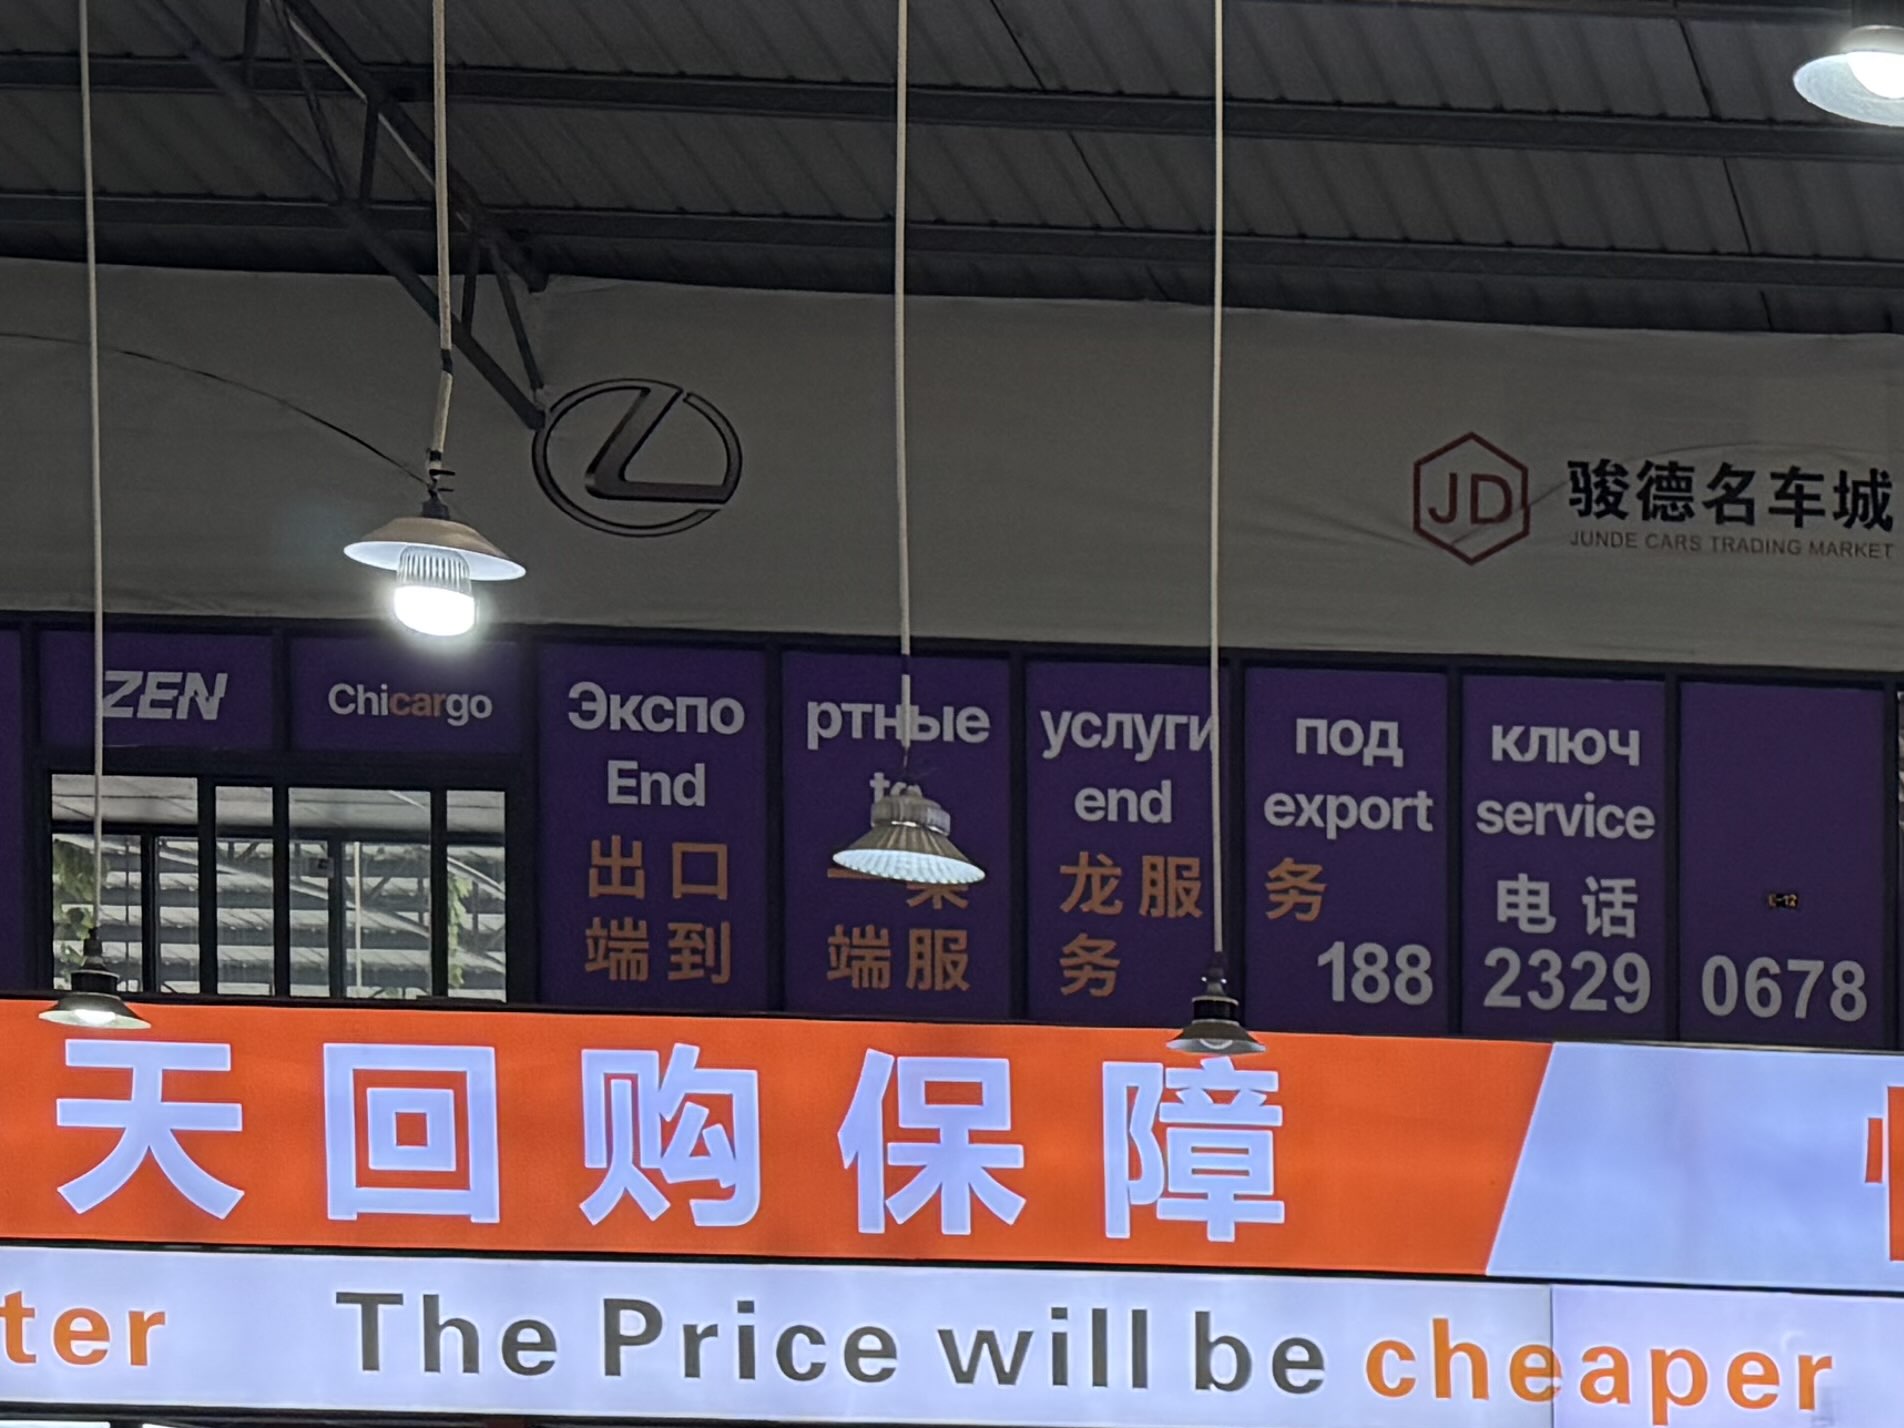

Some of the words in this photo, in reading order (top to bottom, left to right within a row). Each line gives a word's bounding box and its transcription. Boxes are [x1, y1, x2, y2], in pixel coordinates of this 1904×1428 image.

[1428, 472, 1514, 526] JD
[1567, 457, 1895, 534] 骏德名车城
[1569, 530, 1638, 550] JUNDE
[1645, 532, 1700, 553] CARS
[1709, 535, 1803, 557] TRADING
[1809, 540, 1894, 560] MARKET
[101, 670, 228, 721] ZEN
[328, 683, 493, 727] Chicargo
[568, 681, 745, 735] Экспо
[807, 700, 991, 751] ртные
[1040, 710, 1216, 762] услуги
[1296, 718, 1404, 768] под
[1491, 724, 1640, 767] ключ
[607, 760, 706, 807] End
[1074, 779, 1172, 824] end
[1264, 790, 1434, 841] export
[1476, 792, 1656, 840] service
[1496, 873, 1638, 938] 电话
[1317, 941, 1433, 1006] 188
[1482, 947, 1652, 1015] 2329
[1701, 955, 1868, 1022] 0678
[56, 1036, 1287, 1243] 天回购保障
[336, 1292, 556, 1376] The
[604, 1299, 896, 1382] Price
[938, 1307, 1147, 1388] will
[1196, 1311, 1323, 1394] be
[1367, 1318, 1832, 1425] cheaper
